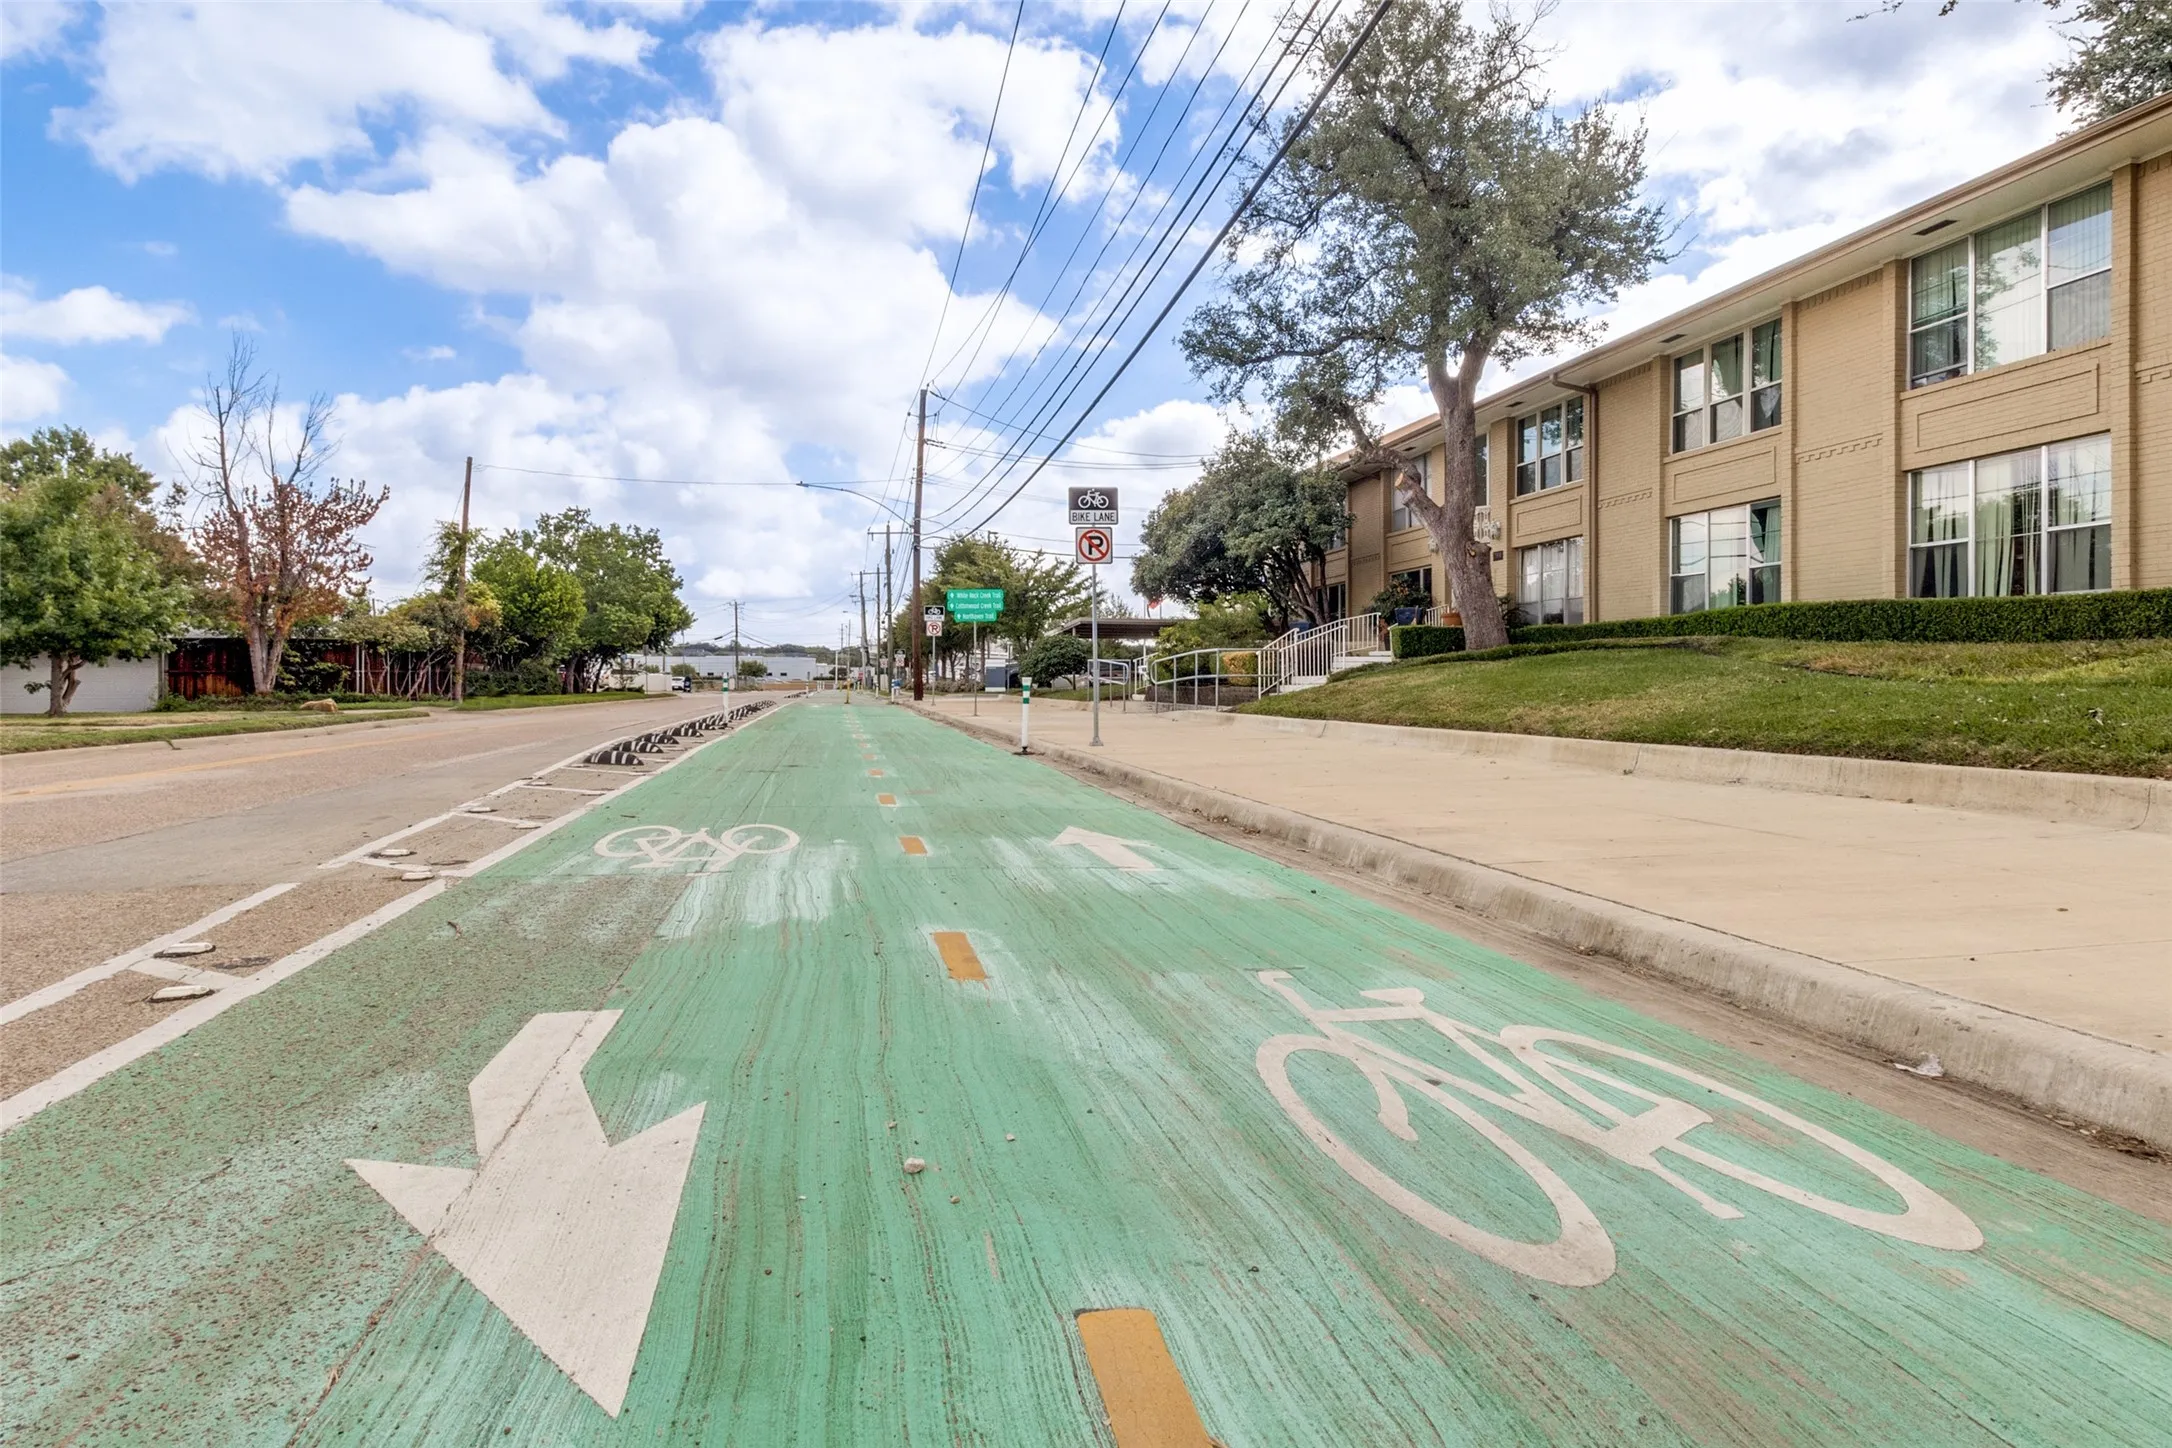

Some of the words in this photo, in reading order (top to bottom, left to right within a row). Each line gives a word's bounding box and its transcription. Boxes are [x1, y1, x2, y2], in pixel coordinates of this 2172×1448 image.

[1072, 512, 1091, 522] BIKE
[1094, 512, 1115, 522] LANE
[1088, 535, 1103, 555] P
